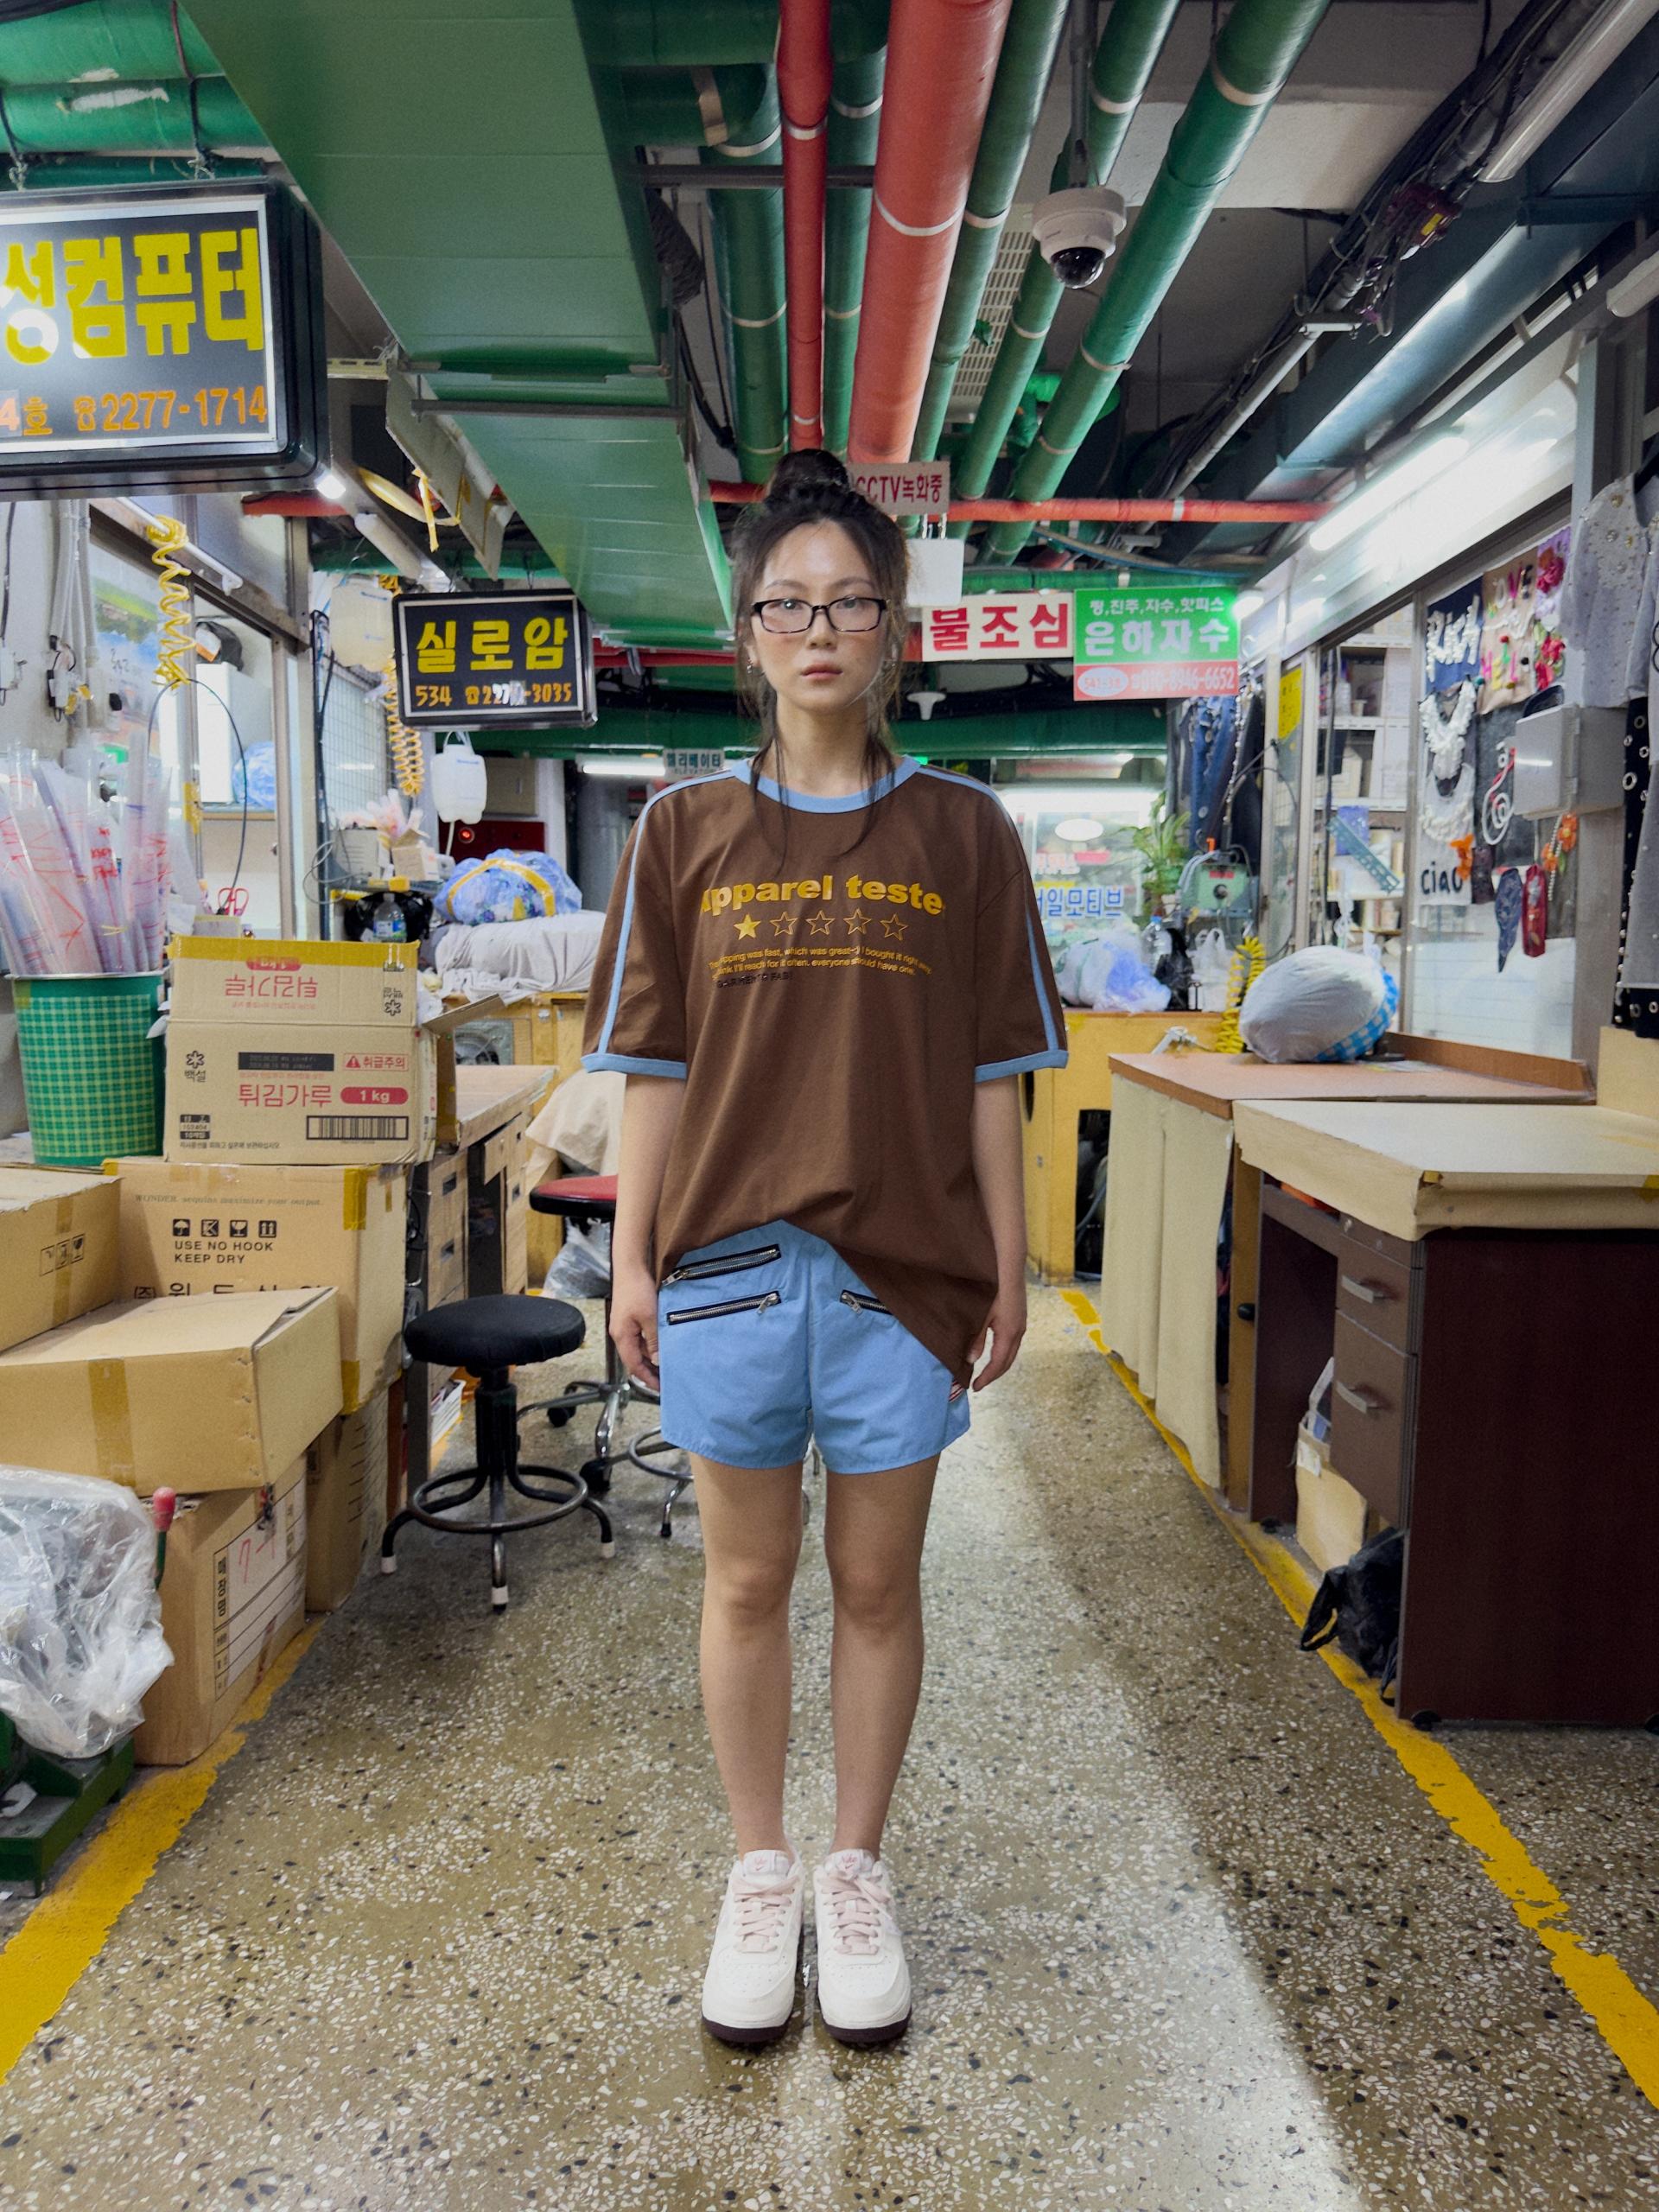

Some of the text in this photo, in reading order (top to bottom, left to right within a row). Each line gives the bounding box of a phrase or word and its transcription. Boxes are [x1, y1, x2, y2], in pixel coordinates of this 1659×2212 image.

[0, 228, 264, 366] 성컴퓨터
[930, 604, 1069, 652] 불조심
[1084, 618, 1230, 657] 은하자수
[416, 616, 569, 674] 실로암
[415, 684, 453, 708] 534
[1421, 861, 1463, 895] ciao
[363, 1056, 406, 1070] 취급주의
[238, 1084, 332, 1109] 튀김가루
[175, 1240, 273, 1251] USE NO HOOK
[175, 1253, 245, 1264] KEEP DRY
